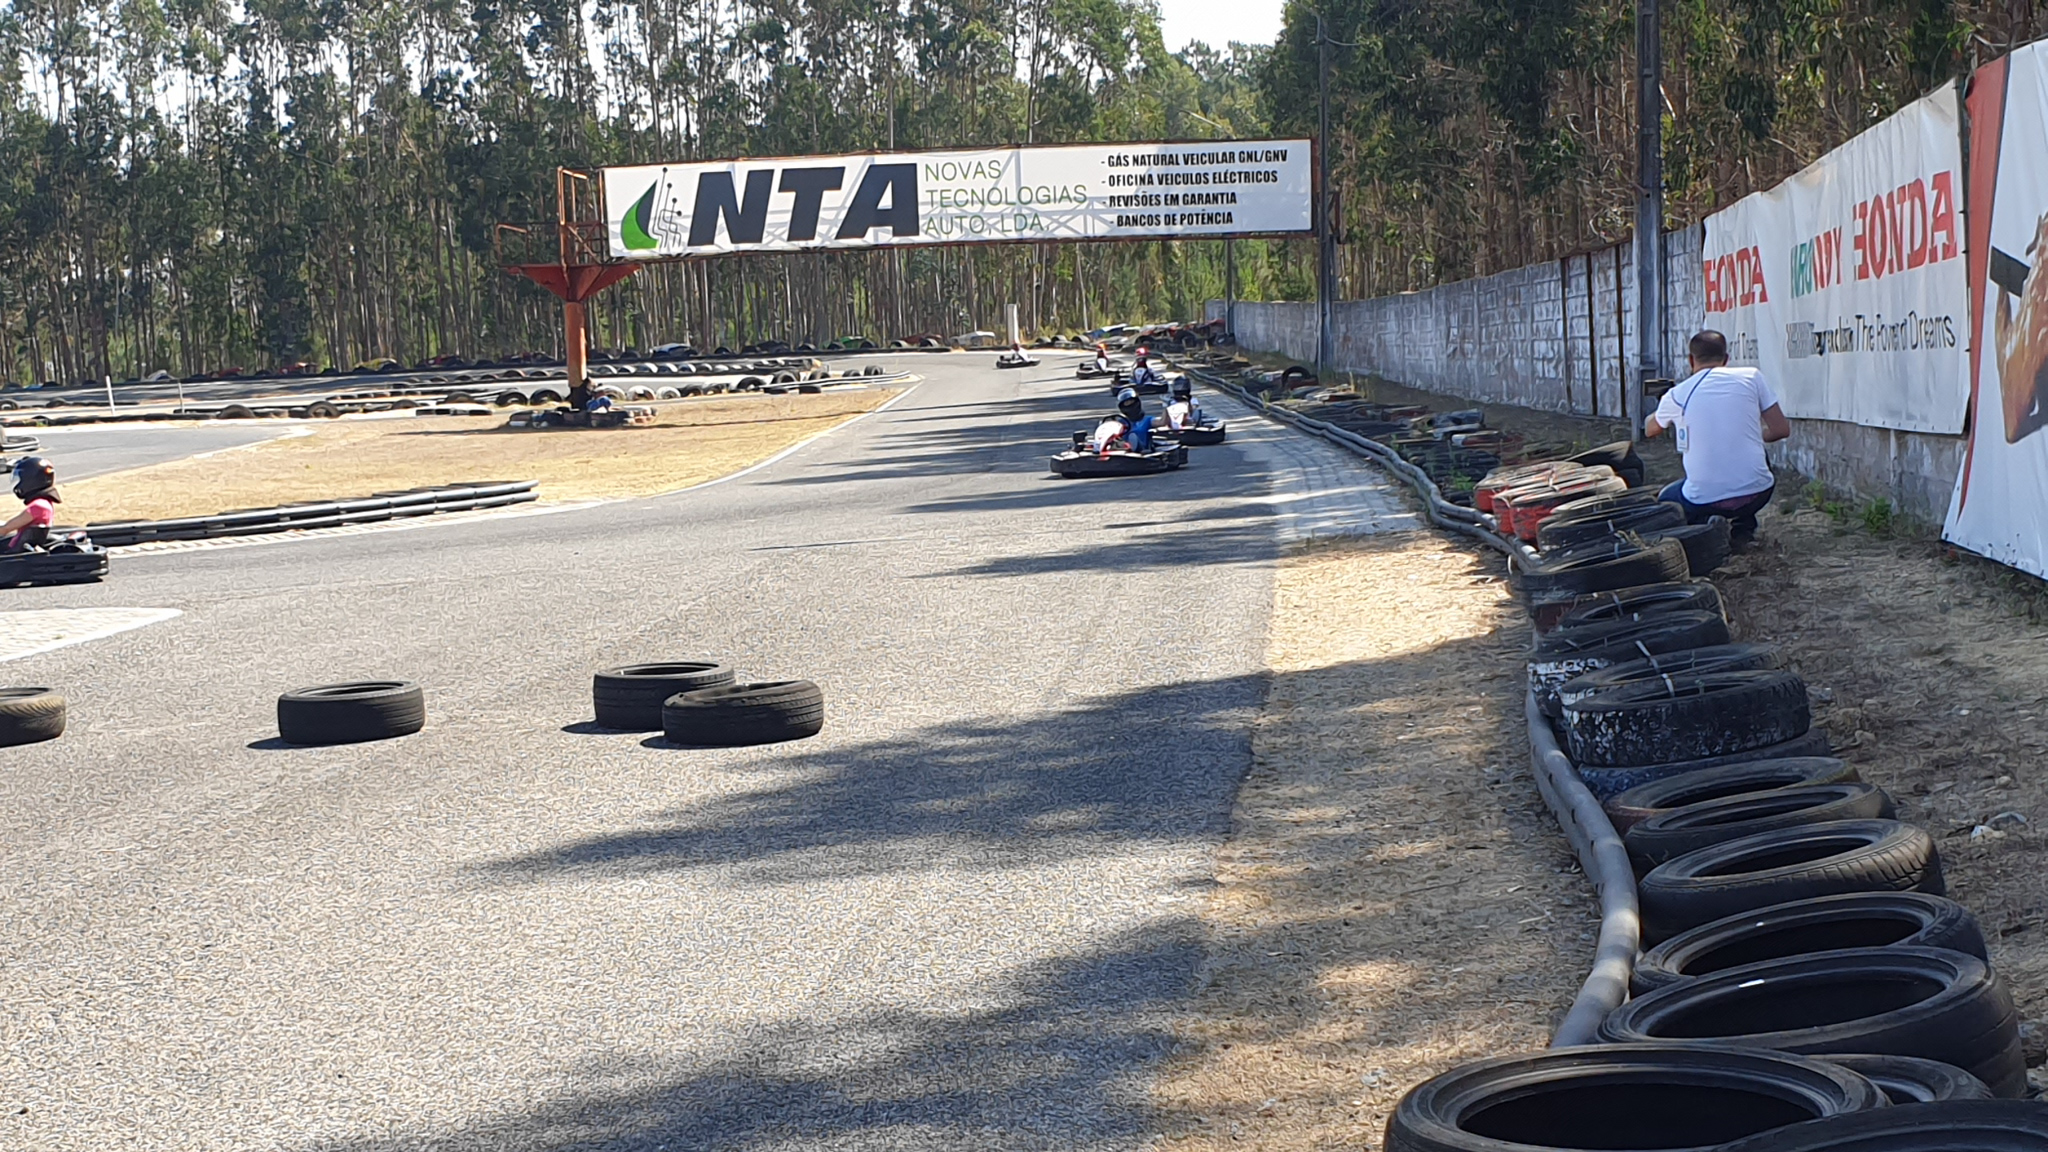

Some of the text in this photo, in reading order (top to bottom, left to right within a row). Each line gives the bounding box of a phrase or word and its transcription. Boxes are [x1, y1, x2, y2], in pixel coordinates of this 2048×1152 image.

[1107, 152, 1129, 168] GÁS
[1132, 154, 1180, 167] NATURAL
[1183, 151, 1236, 166] VEICULAR
[1239, 149, 1288, 163] GNL/GNV
[925, 160, 1002, 182] NOVAS
[1108, 173, 1155, 187] OFICINA
[1157, 172, 1210, 186] VEICULOS
[1212, 169, 1278, 184] ELÉCTRICOS
[687, 163, 920, 246] NTA
[925, 184, 1088, 209] TECNOLOGIAS
[1109, 191, 1161, 208] REVISÕES
[1164, 193, 1180, 207] EM
[1182, 192, 1237, 206] GARANTIA
[1117, 213, 1161, 227] BANCOS
[1164, 213, 1177, 226] DE
[1179, 209, 1234, 226] POTÊNCIA
[1704, 245, 1769, 313] HONDA
[1855, 314, 1875, 352] The
[1908, 309, 1957, 350] Dreams
